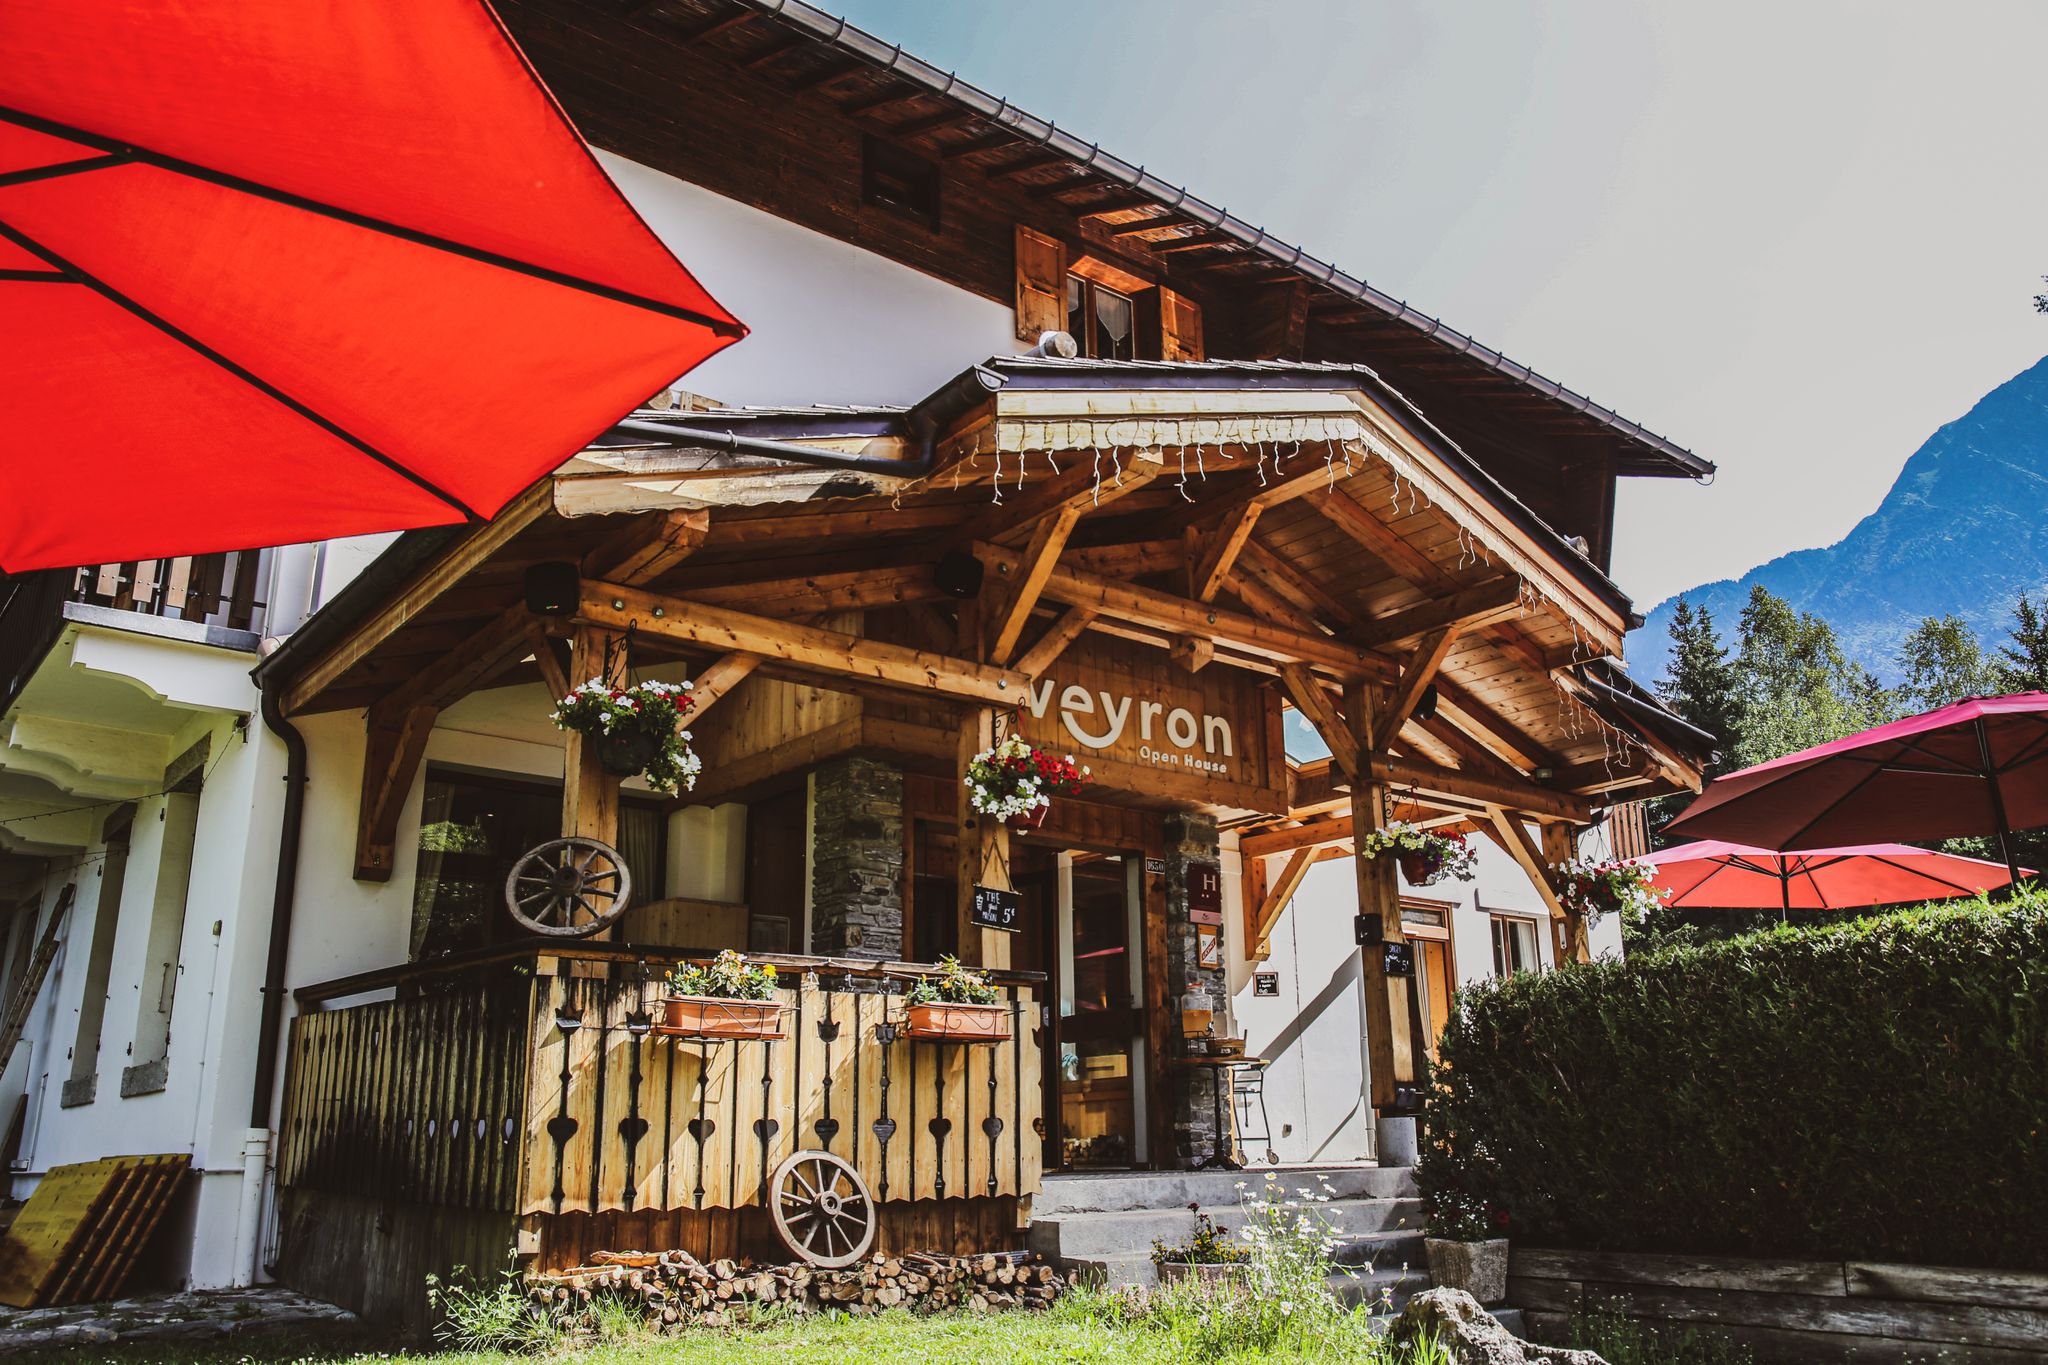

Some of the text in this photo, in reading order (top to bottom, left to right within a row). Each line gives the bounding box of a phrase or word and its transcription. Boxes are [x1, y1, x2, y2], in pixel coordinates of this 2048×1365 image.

[1139, 745, 1227, 773] Open House
[1203, 873, 1217, 892] H
